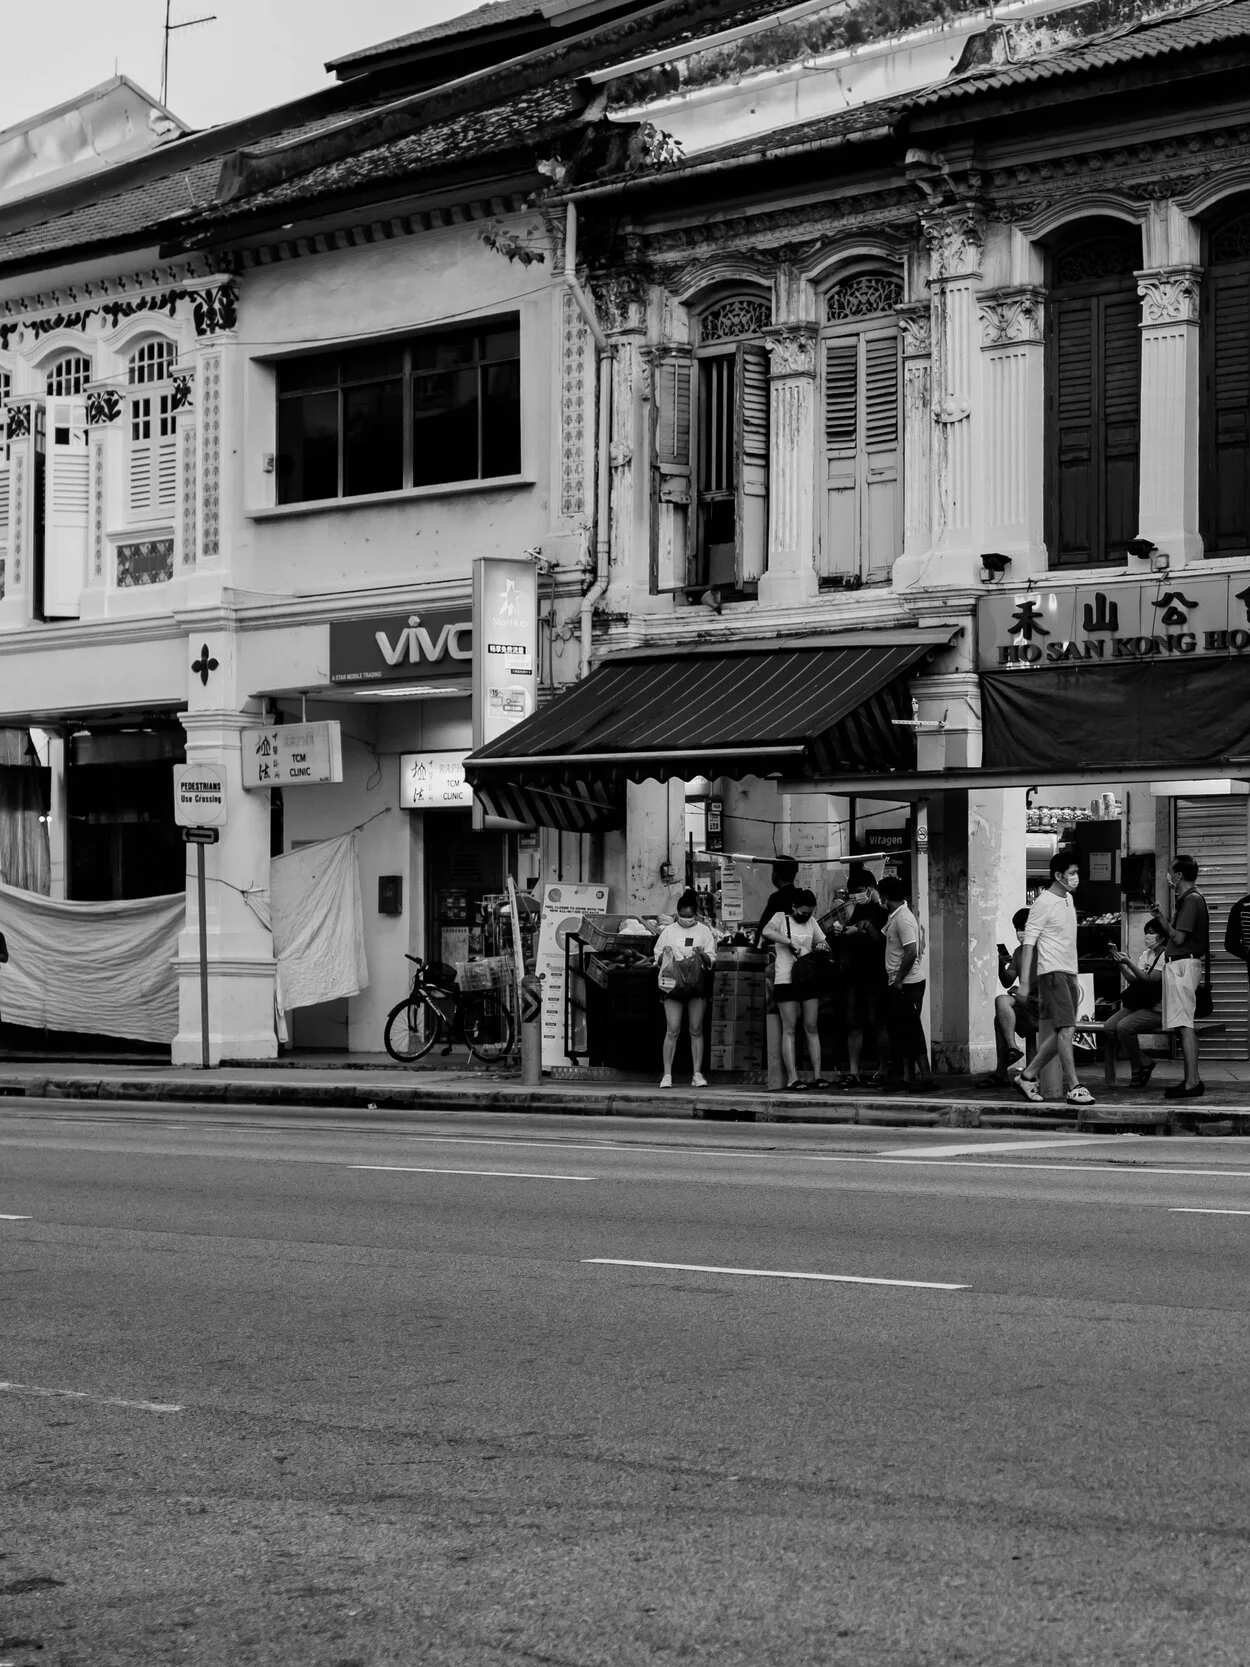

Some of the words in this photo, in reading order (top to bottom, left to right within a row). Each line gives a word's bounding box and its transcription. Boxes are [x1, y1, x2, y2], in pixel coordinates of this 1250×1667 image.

[996, 644, 1042, 664] HO
[1046, 639, 1106, 661] SAN
[1110, 632, 1198, 657] KONG
[347, 672, 363, 680] MOBILE
[363, 671, 382, 679] TRADING
[291, 754, 306, 763] TCM
[289, 767, 311, 777] CLINIC
[180, 782, 221, 791] PEDESTRIANS
[181, 795, 192, 803] Use
[194, 795, 222, 804] Crossing
[443, 792, 463, 800] CLINIC
[869, 835, 903, 846] Vitagen
